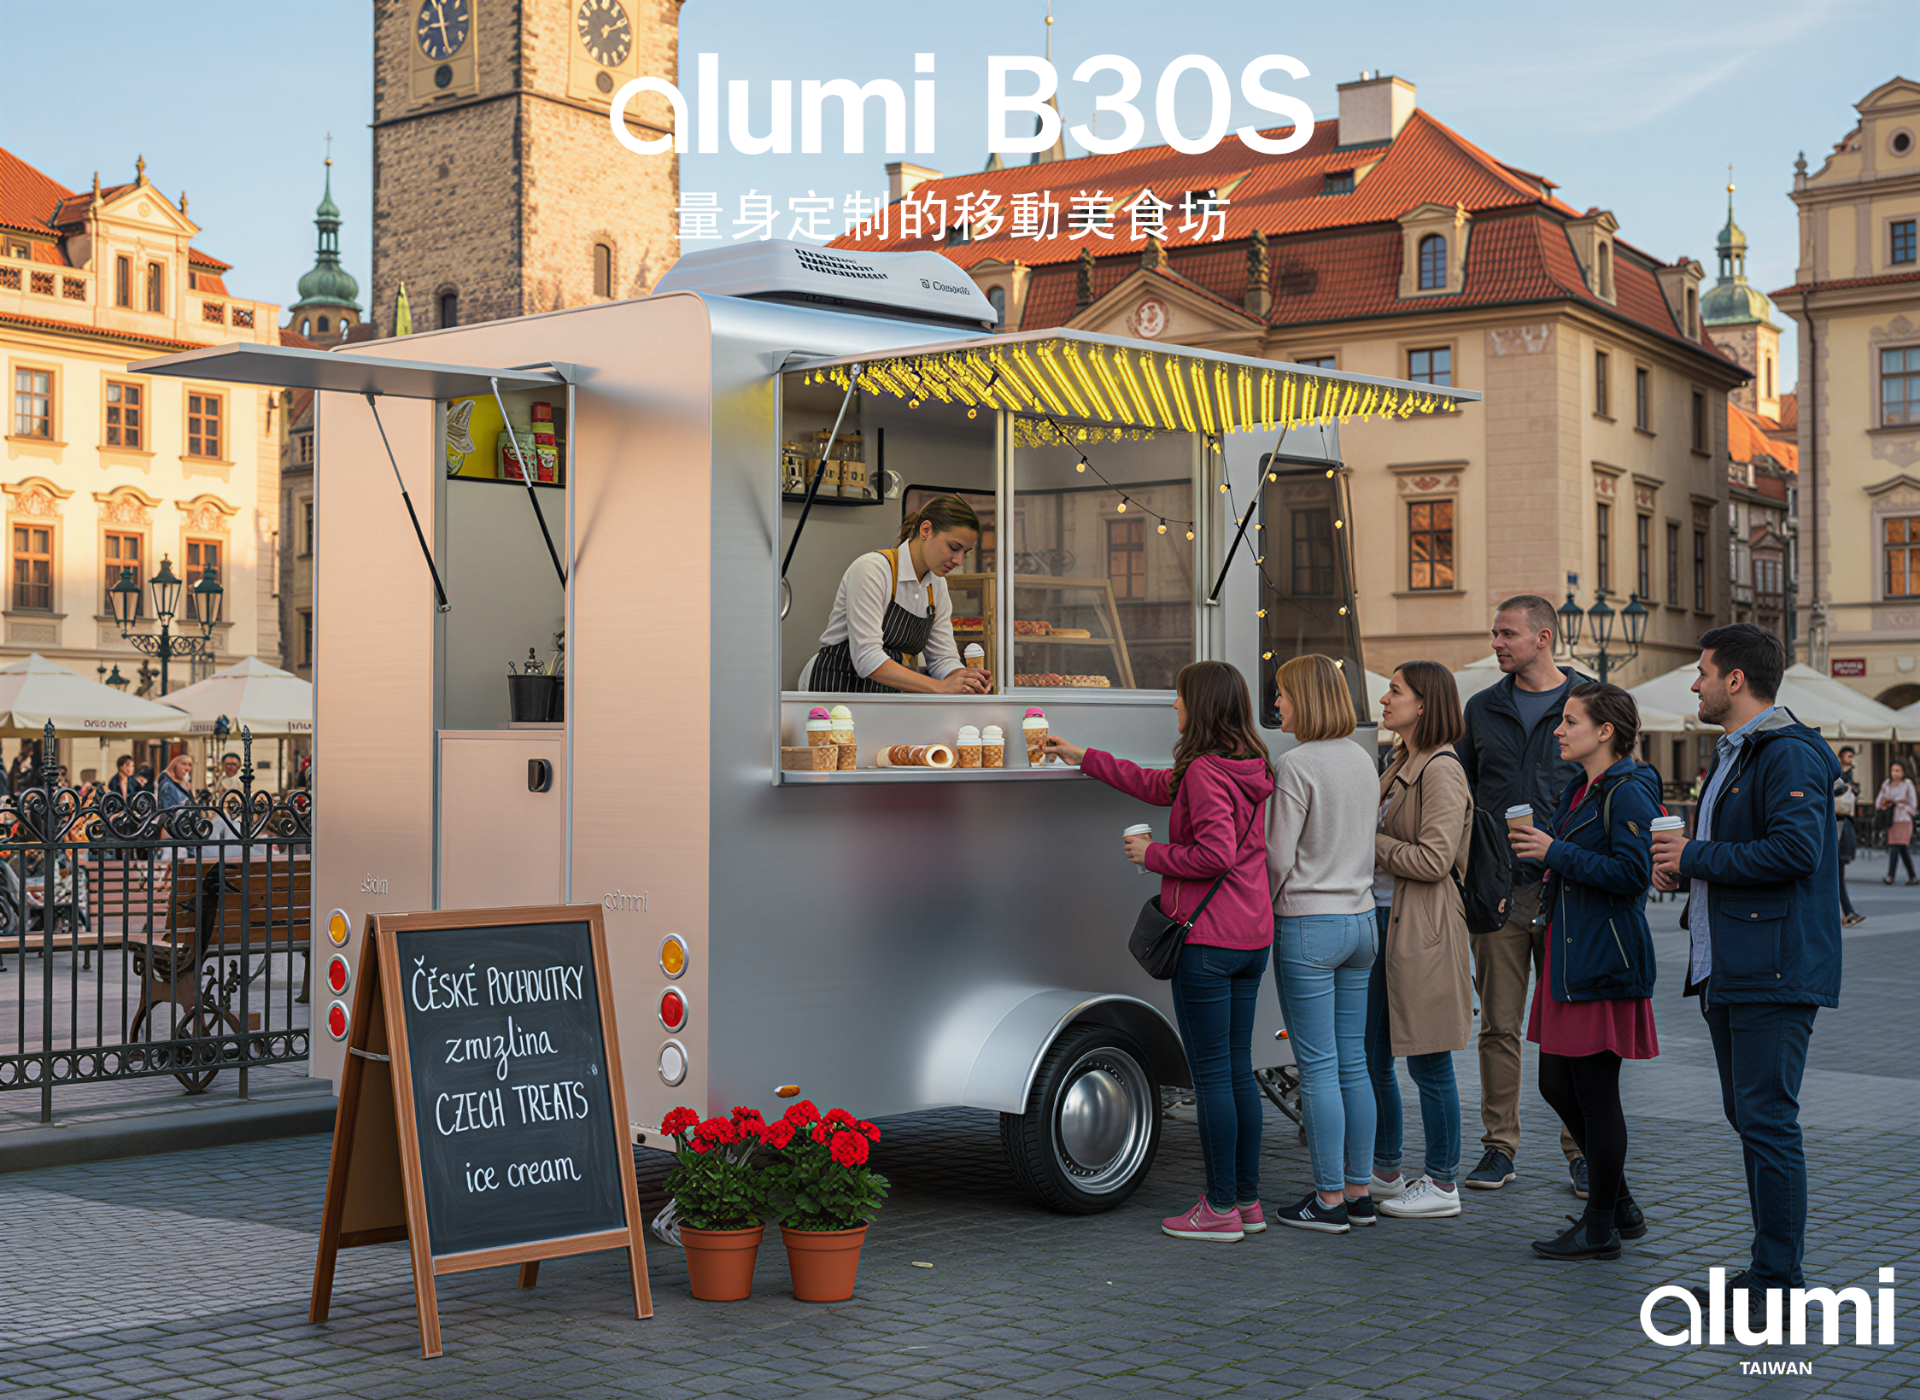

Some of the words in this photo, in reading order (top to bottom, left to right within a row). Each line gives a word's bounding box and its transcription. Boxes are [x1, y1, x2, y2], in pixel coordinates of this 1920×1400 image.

[435, 1087, 506, 1136] CZECH
[511, 1081, 589, 1125] TREATS
[465, 1162, 500, 1193] ice
[507, 1156, 582, 1188] cream
